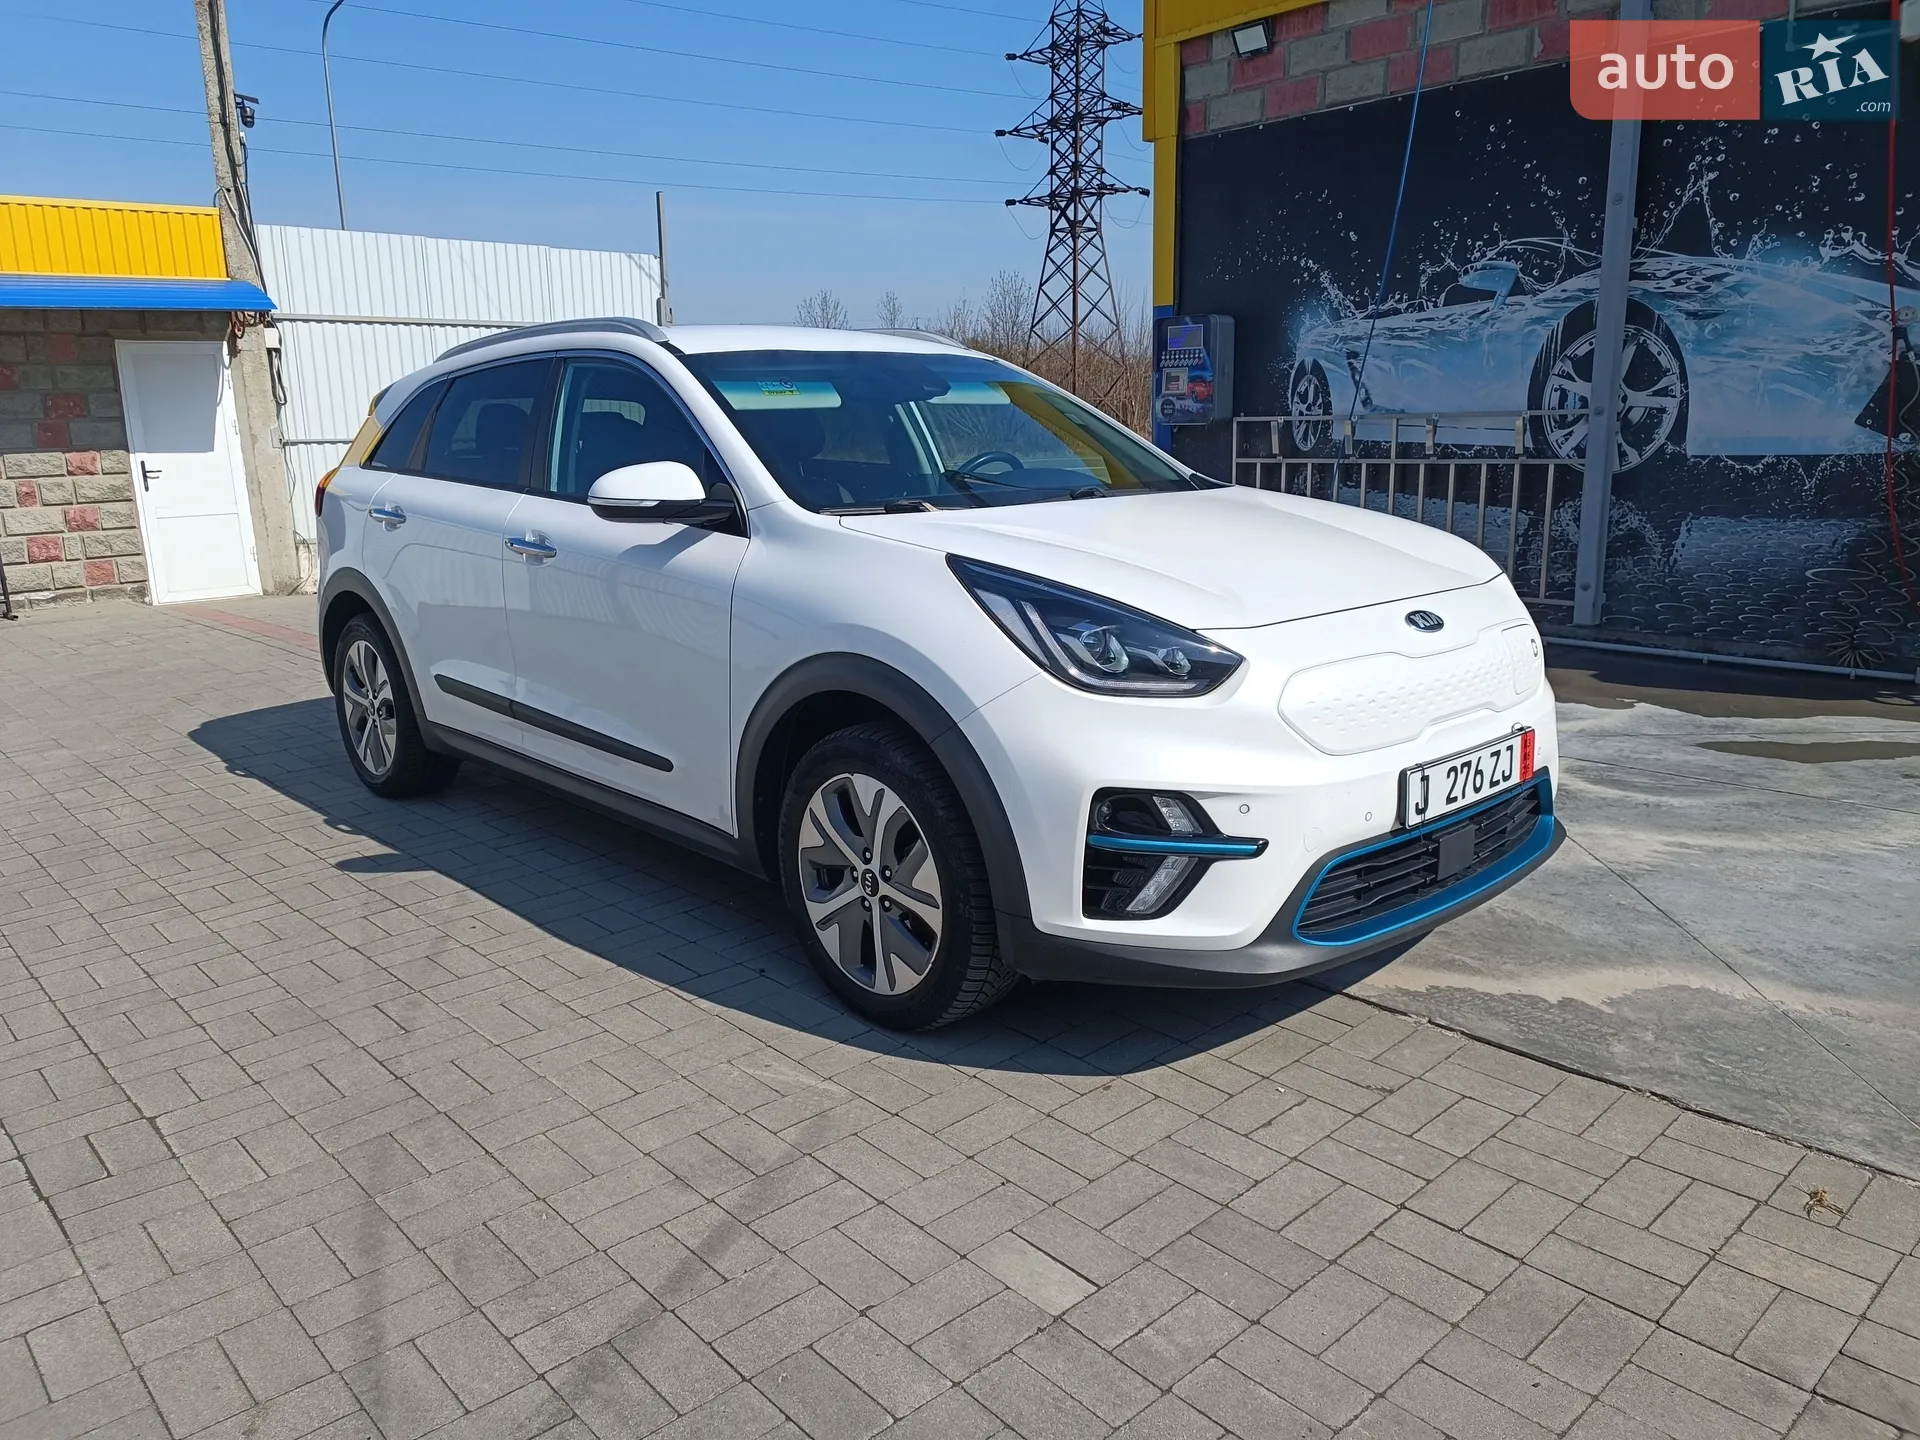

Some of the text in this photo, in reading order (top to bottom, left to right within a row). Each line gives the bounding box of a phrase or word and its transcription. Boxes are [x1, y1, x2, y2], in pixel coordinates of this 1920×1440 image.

[1409, 611, 1443, 628] KIA
[1414, 774, 1430, 816] J
[1445, 755, 1484, 806] 276
[1489, 744, 1514, 789] ZJ
[864, 873, 873, 895] KIA
